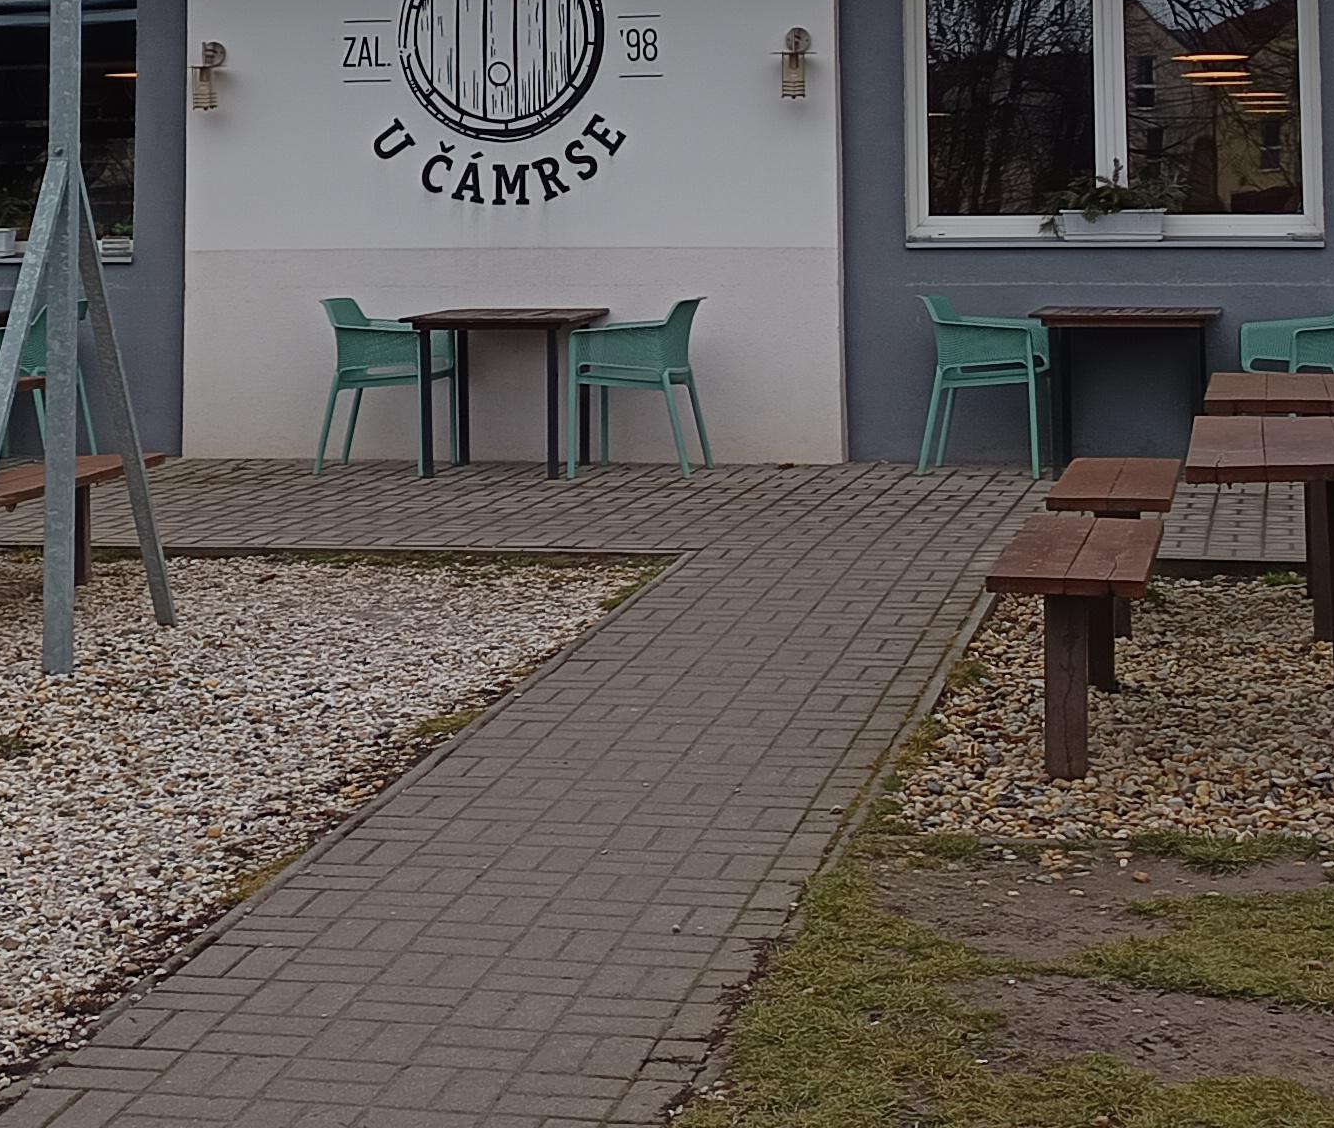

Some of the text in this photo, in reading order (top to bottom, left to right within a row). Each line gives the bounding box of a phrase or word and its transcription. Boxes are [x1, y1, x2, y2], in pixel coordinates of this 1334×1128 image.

[343, 37, 391, 67] ZAL.
[373, 114, 627, 205] U ČÁMRSE
